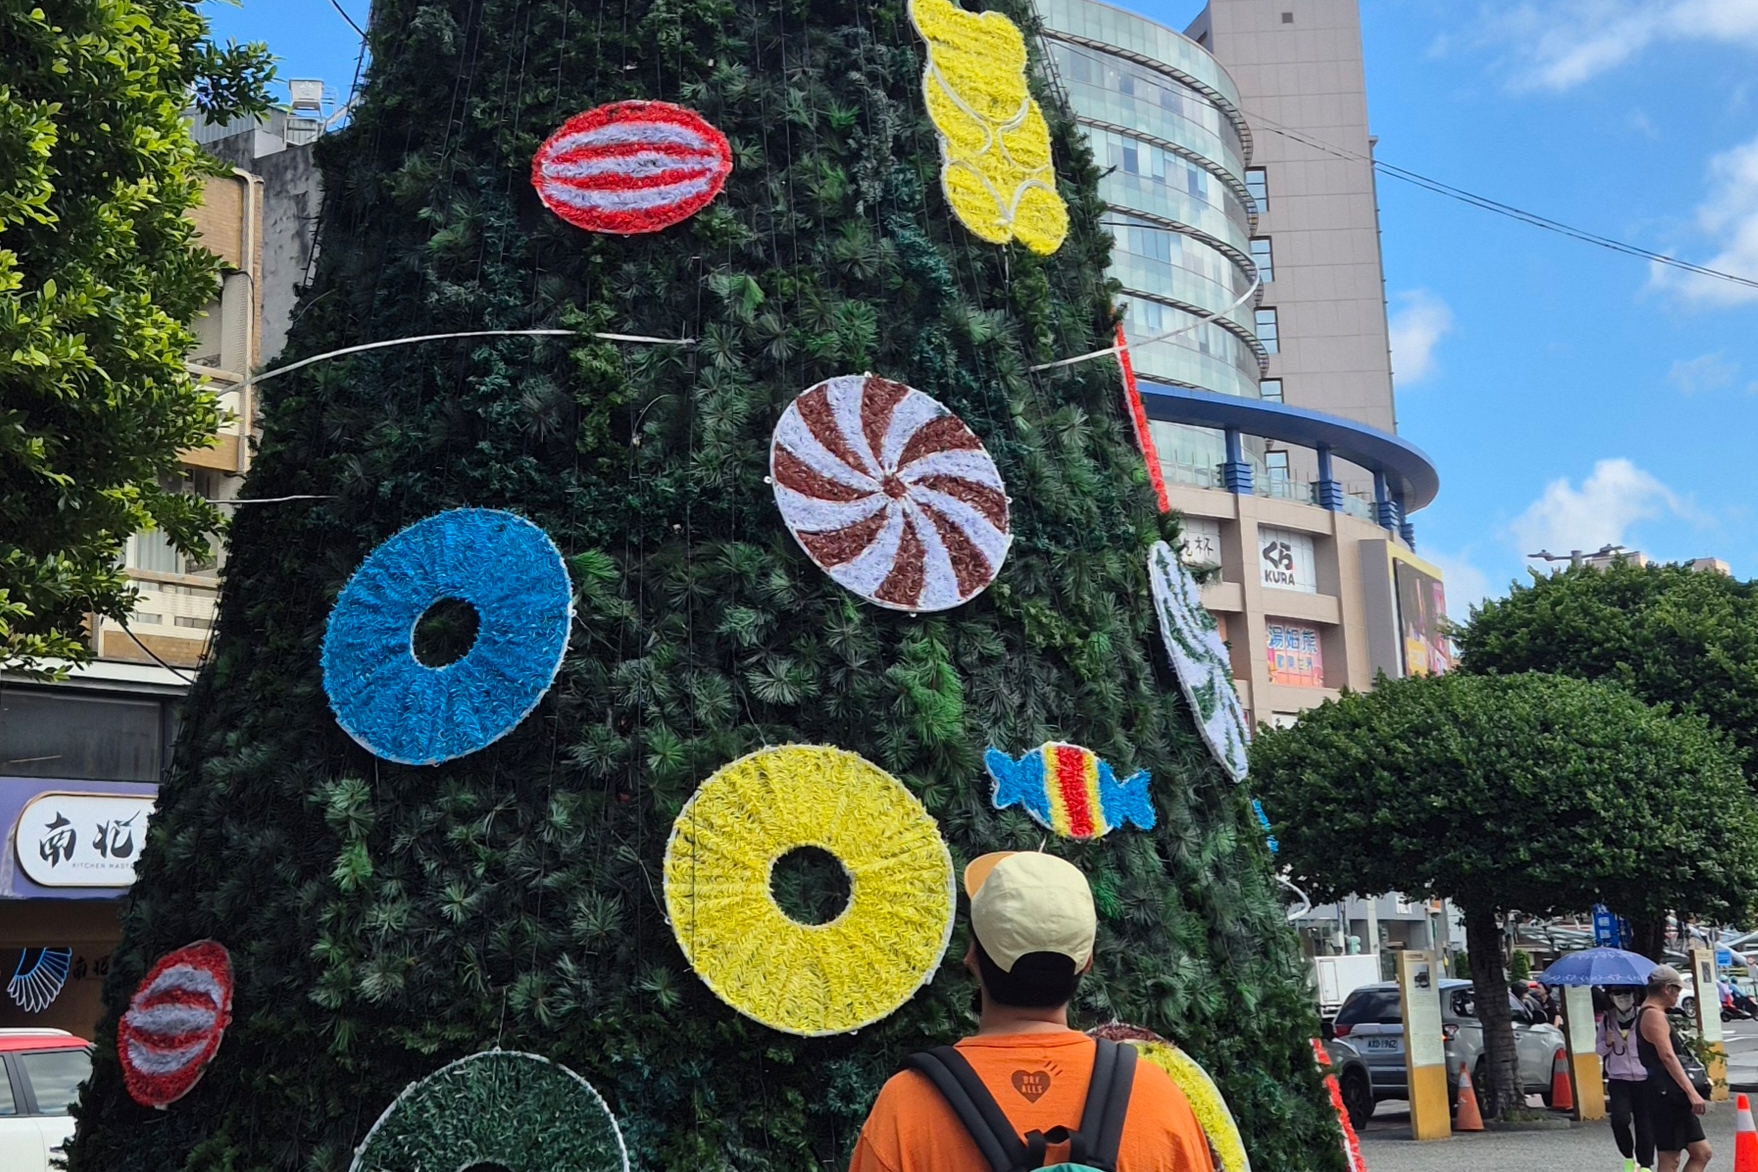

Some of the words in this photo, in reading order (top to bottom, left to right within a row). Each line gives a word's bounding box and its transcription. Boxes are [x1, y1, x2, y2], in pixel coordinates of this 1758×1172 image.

[1262, 541, 1293, 570] くら
[1265, 569, 1295, 585] KURA
[1267, 625, 1318, 653] 湯姆熊
